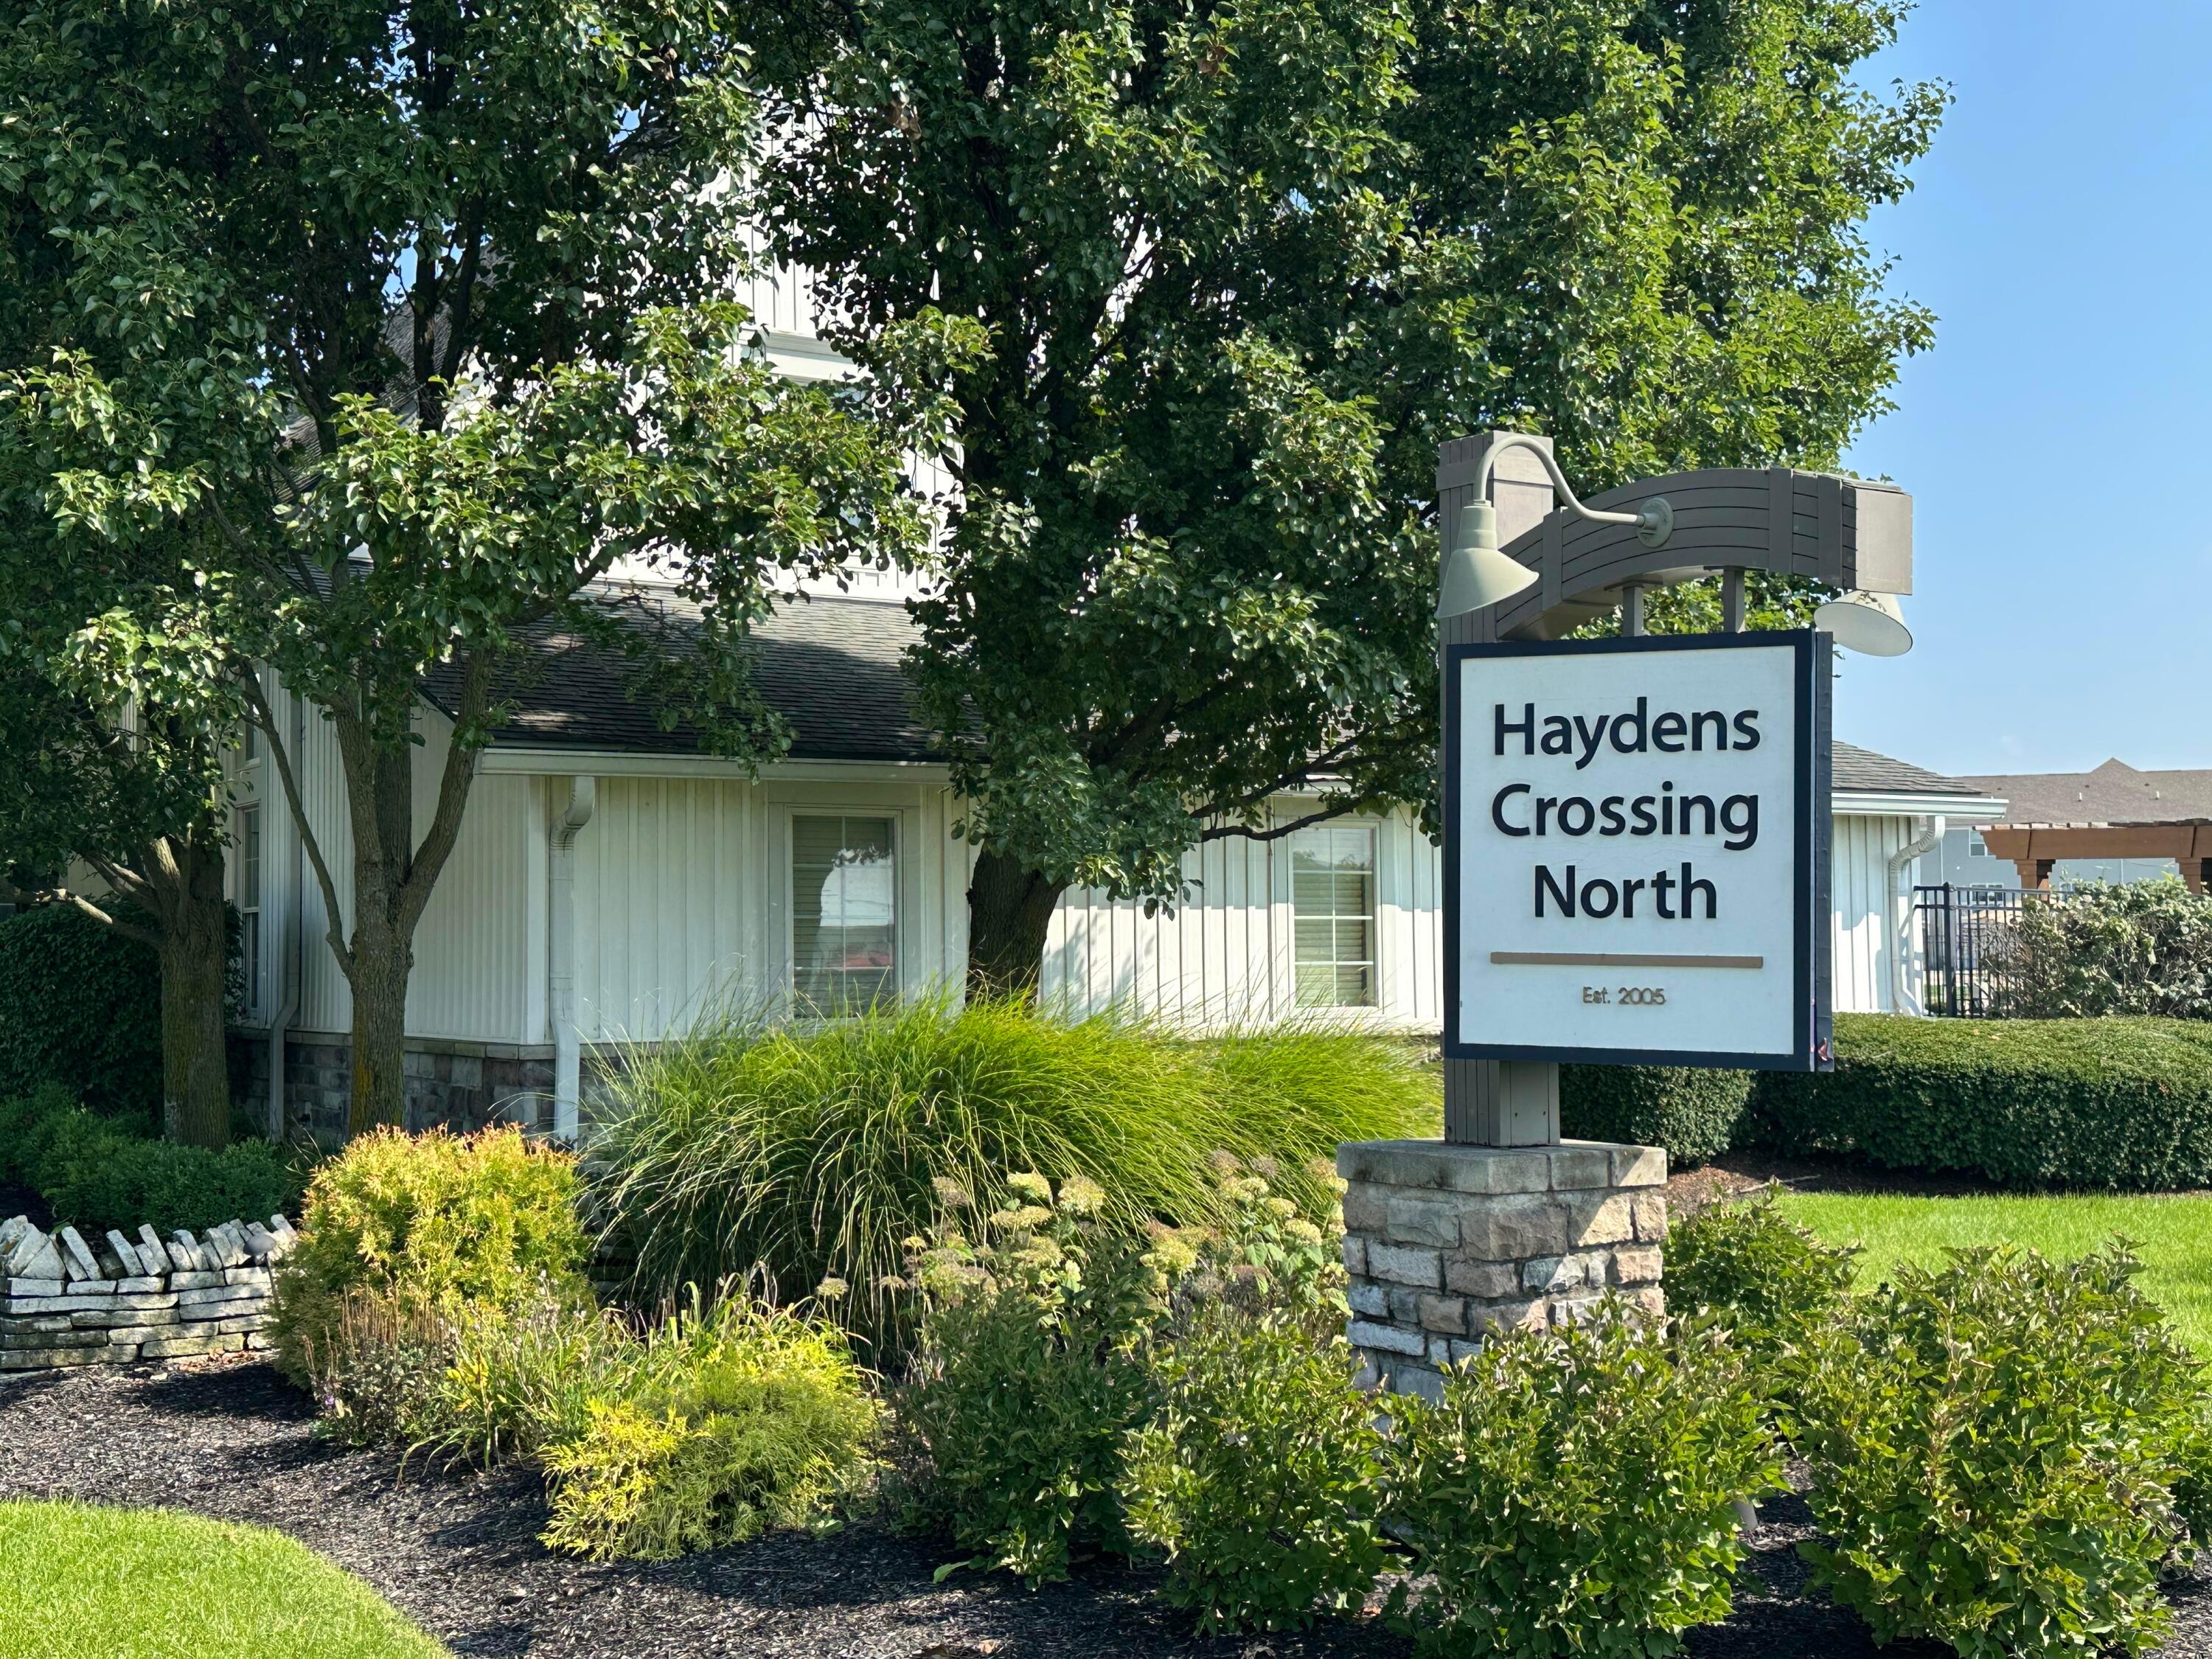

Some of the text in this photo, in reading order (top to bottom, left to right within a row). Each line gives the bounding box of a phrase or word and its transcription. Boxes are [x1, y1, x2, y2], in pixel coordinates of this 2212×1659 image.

[1494, 696, 1761, 771] Haydens
[1491, 780, 1759, 852] Crossing
[1534, 862, 1718, 920] North
[1582, 986, 1667, 1006] Est. 2005
